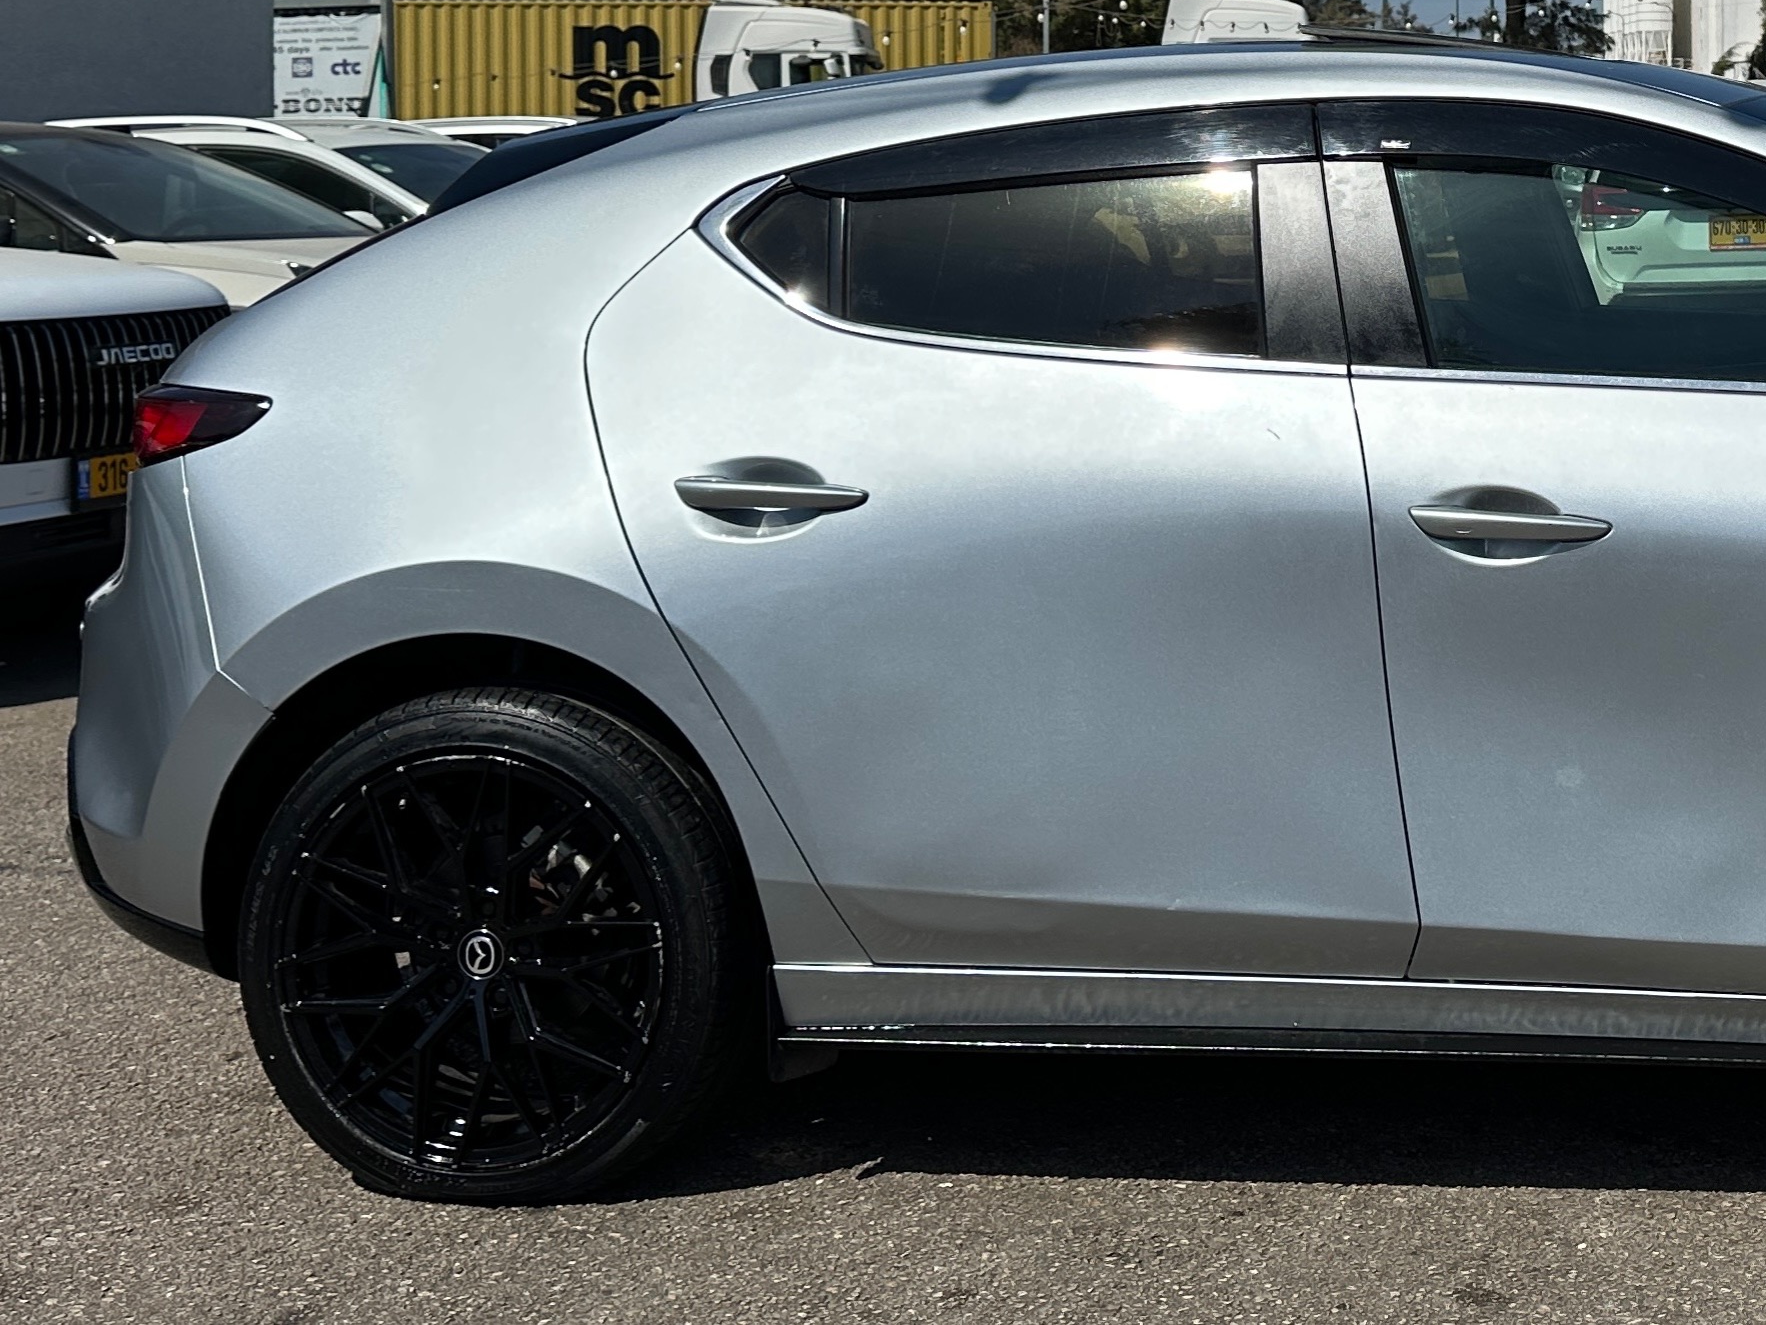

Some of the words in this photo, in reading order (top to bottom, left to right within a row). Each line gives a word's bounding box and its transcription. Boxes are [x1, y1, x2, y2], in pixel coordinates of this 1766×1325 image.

[287, 45, 310, 55] days
[330, 58, 362, 76] ctc
[97, 343, 175, 365] JAECOO
